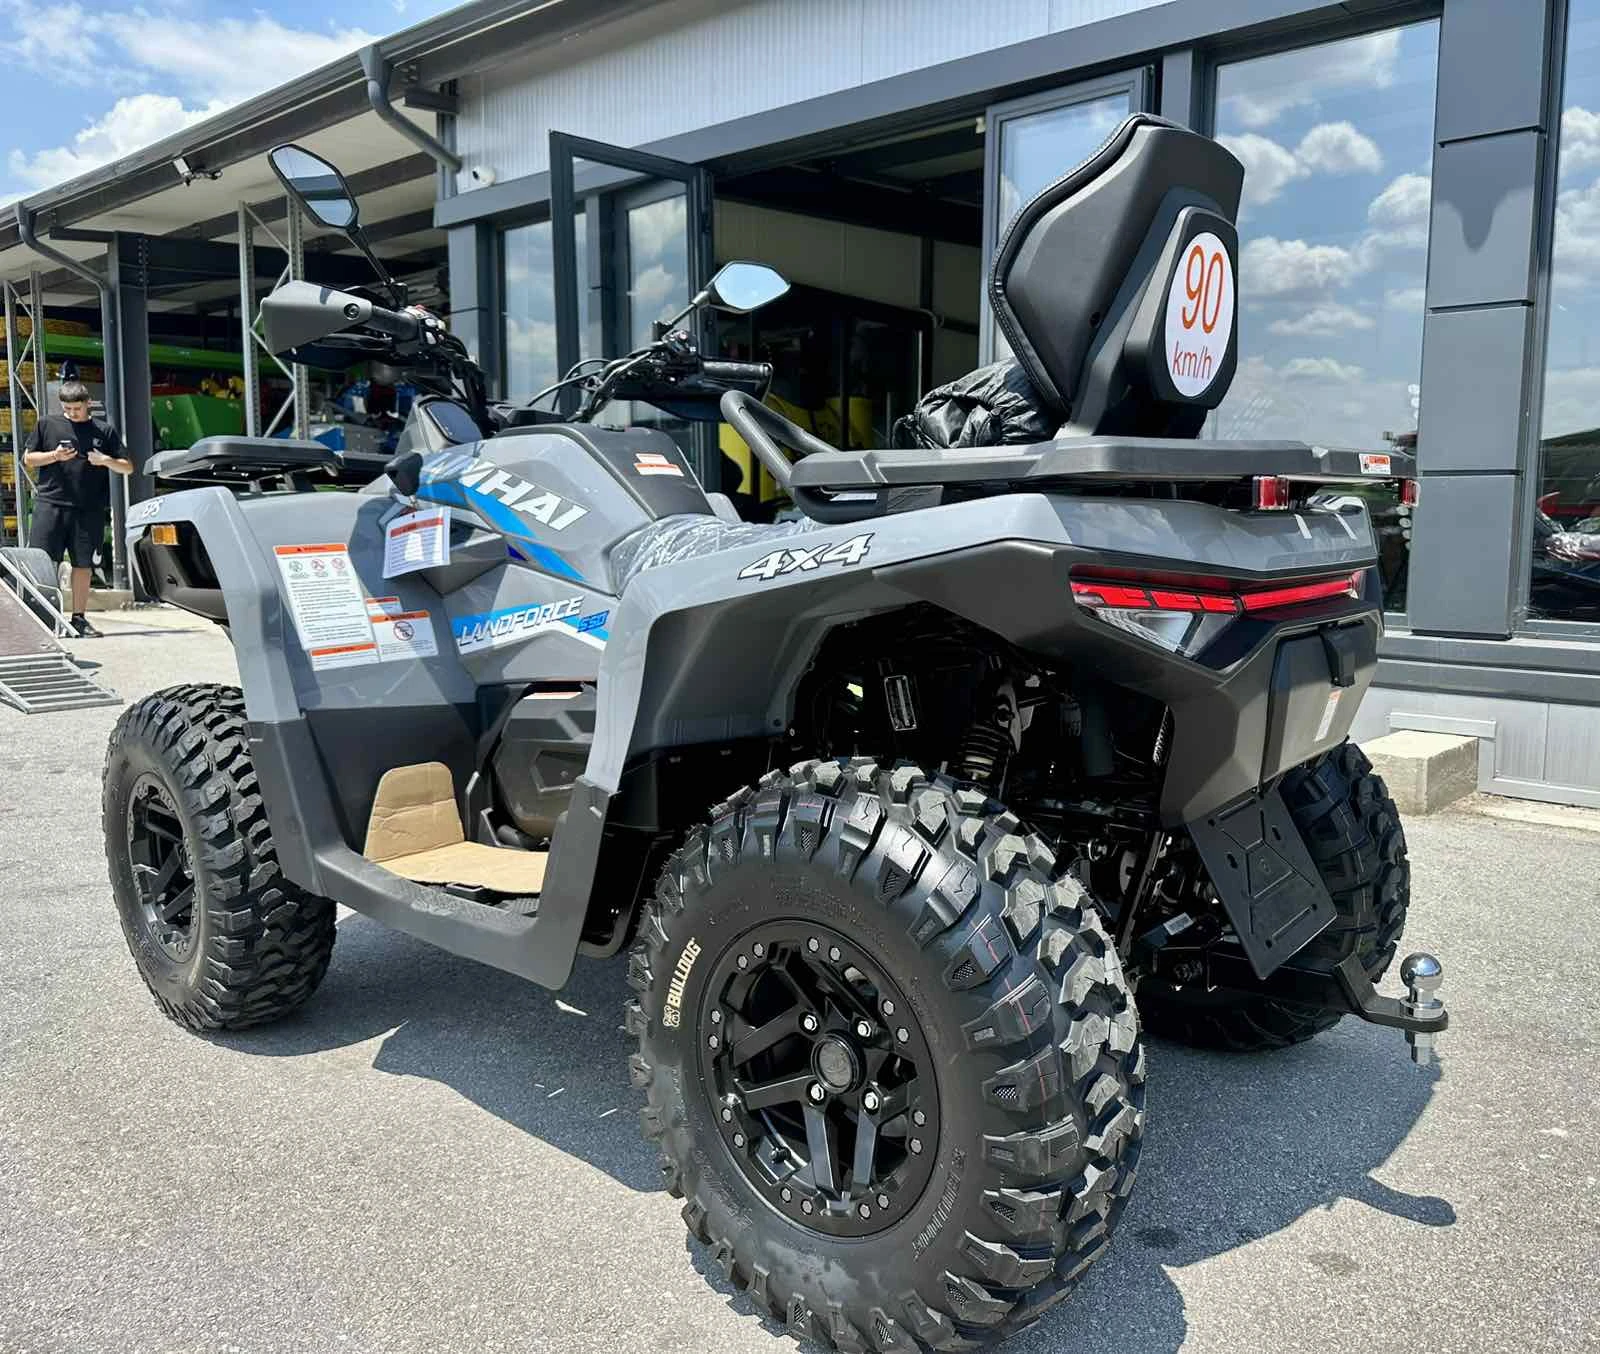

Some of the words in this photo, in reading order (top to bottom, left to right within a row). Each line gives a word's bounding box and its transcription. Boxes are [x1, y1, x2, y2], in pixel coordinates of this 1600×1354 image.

[1181, 244, 1225, 334] 90
[1171, 341, 1213, 380] km/h
[459, 595, 585, 647] LANDFORCE
[667, 938, 702, 1008] BULLDOG
